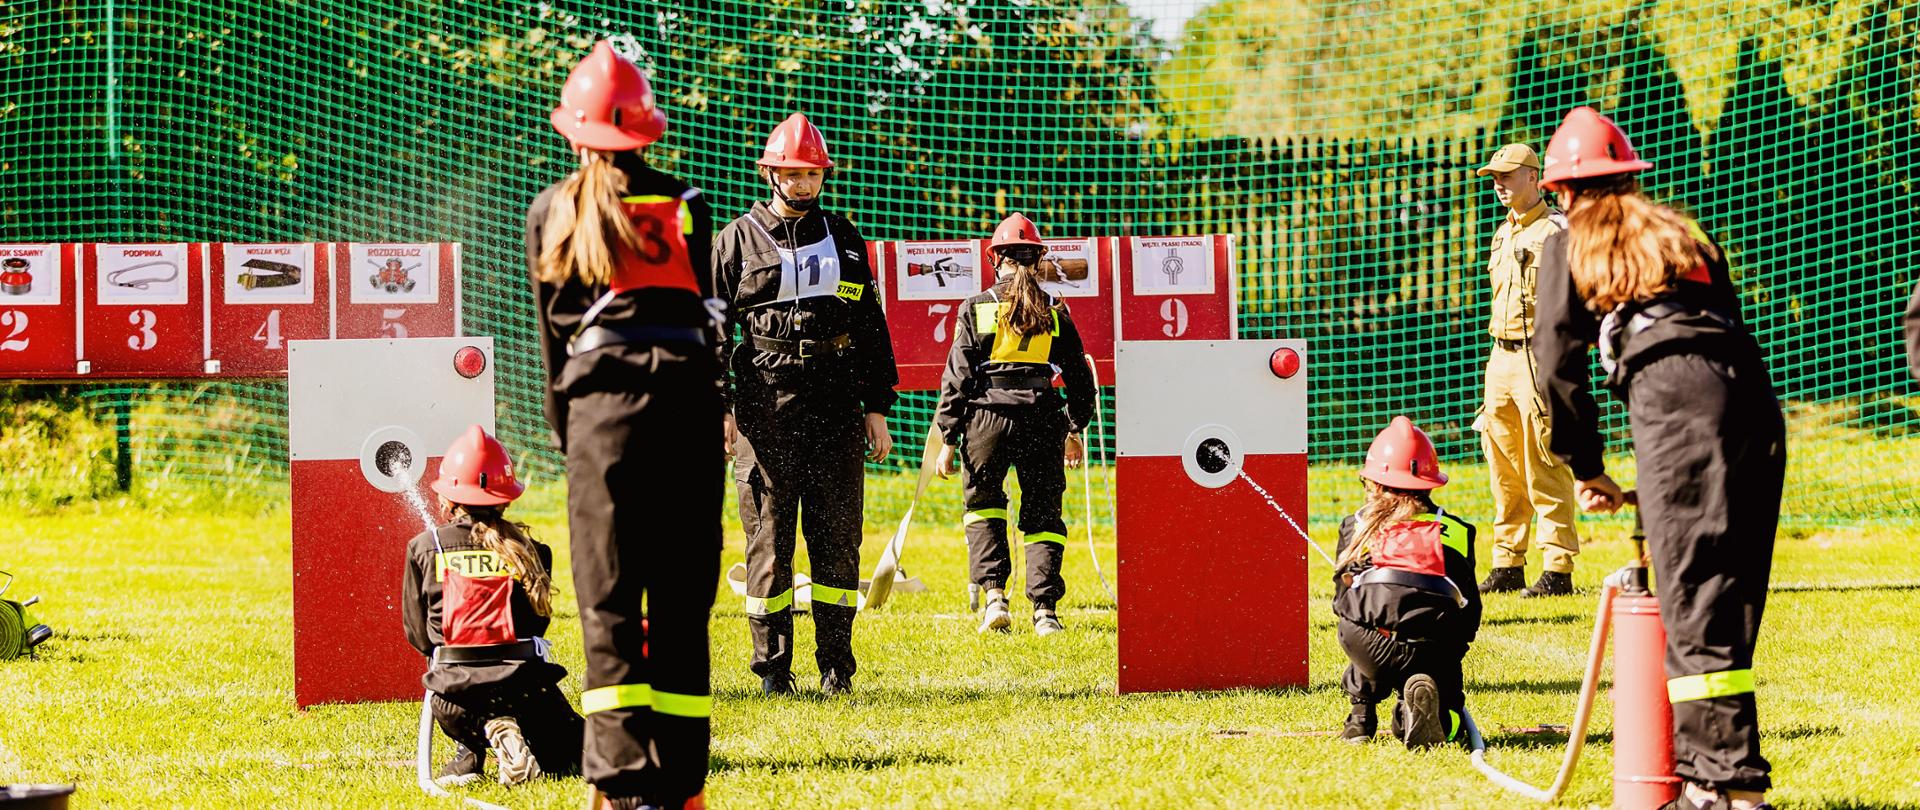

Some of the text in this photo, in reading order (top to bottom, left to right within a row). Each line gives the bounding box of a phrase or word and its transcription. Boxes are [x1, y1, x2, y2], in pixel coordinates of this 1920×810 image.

[367, 248, 421, 257] ROZDZIELACZ
[631, 213, 671, 266] 3
[798, 254, 821, 286] 1
[0, 309, 29, 351] 2
[127, 309, 158, 351] 3
[253, 309, 284, 350] 4
[382, 308, 408, 338] 5
[928, 303, 951, 342] 7
[1159, 298, 1189, 338] 9
